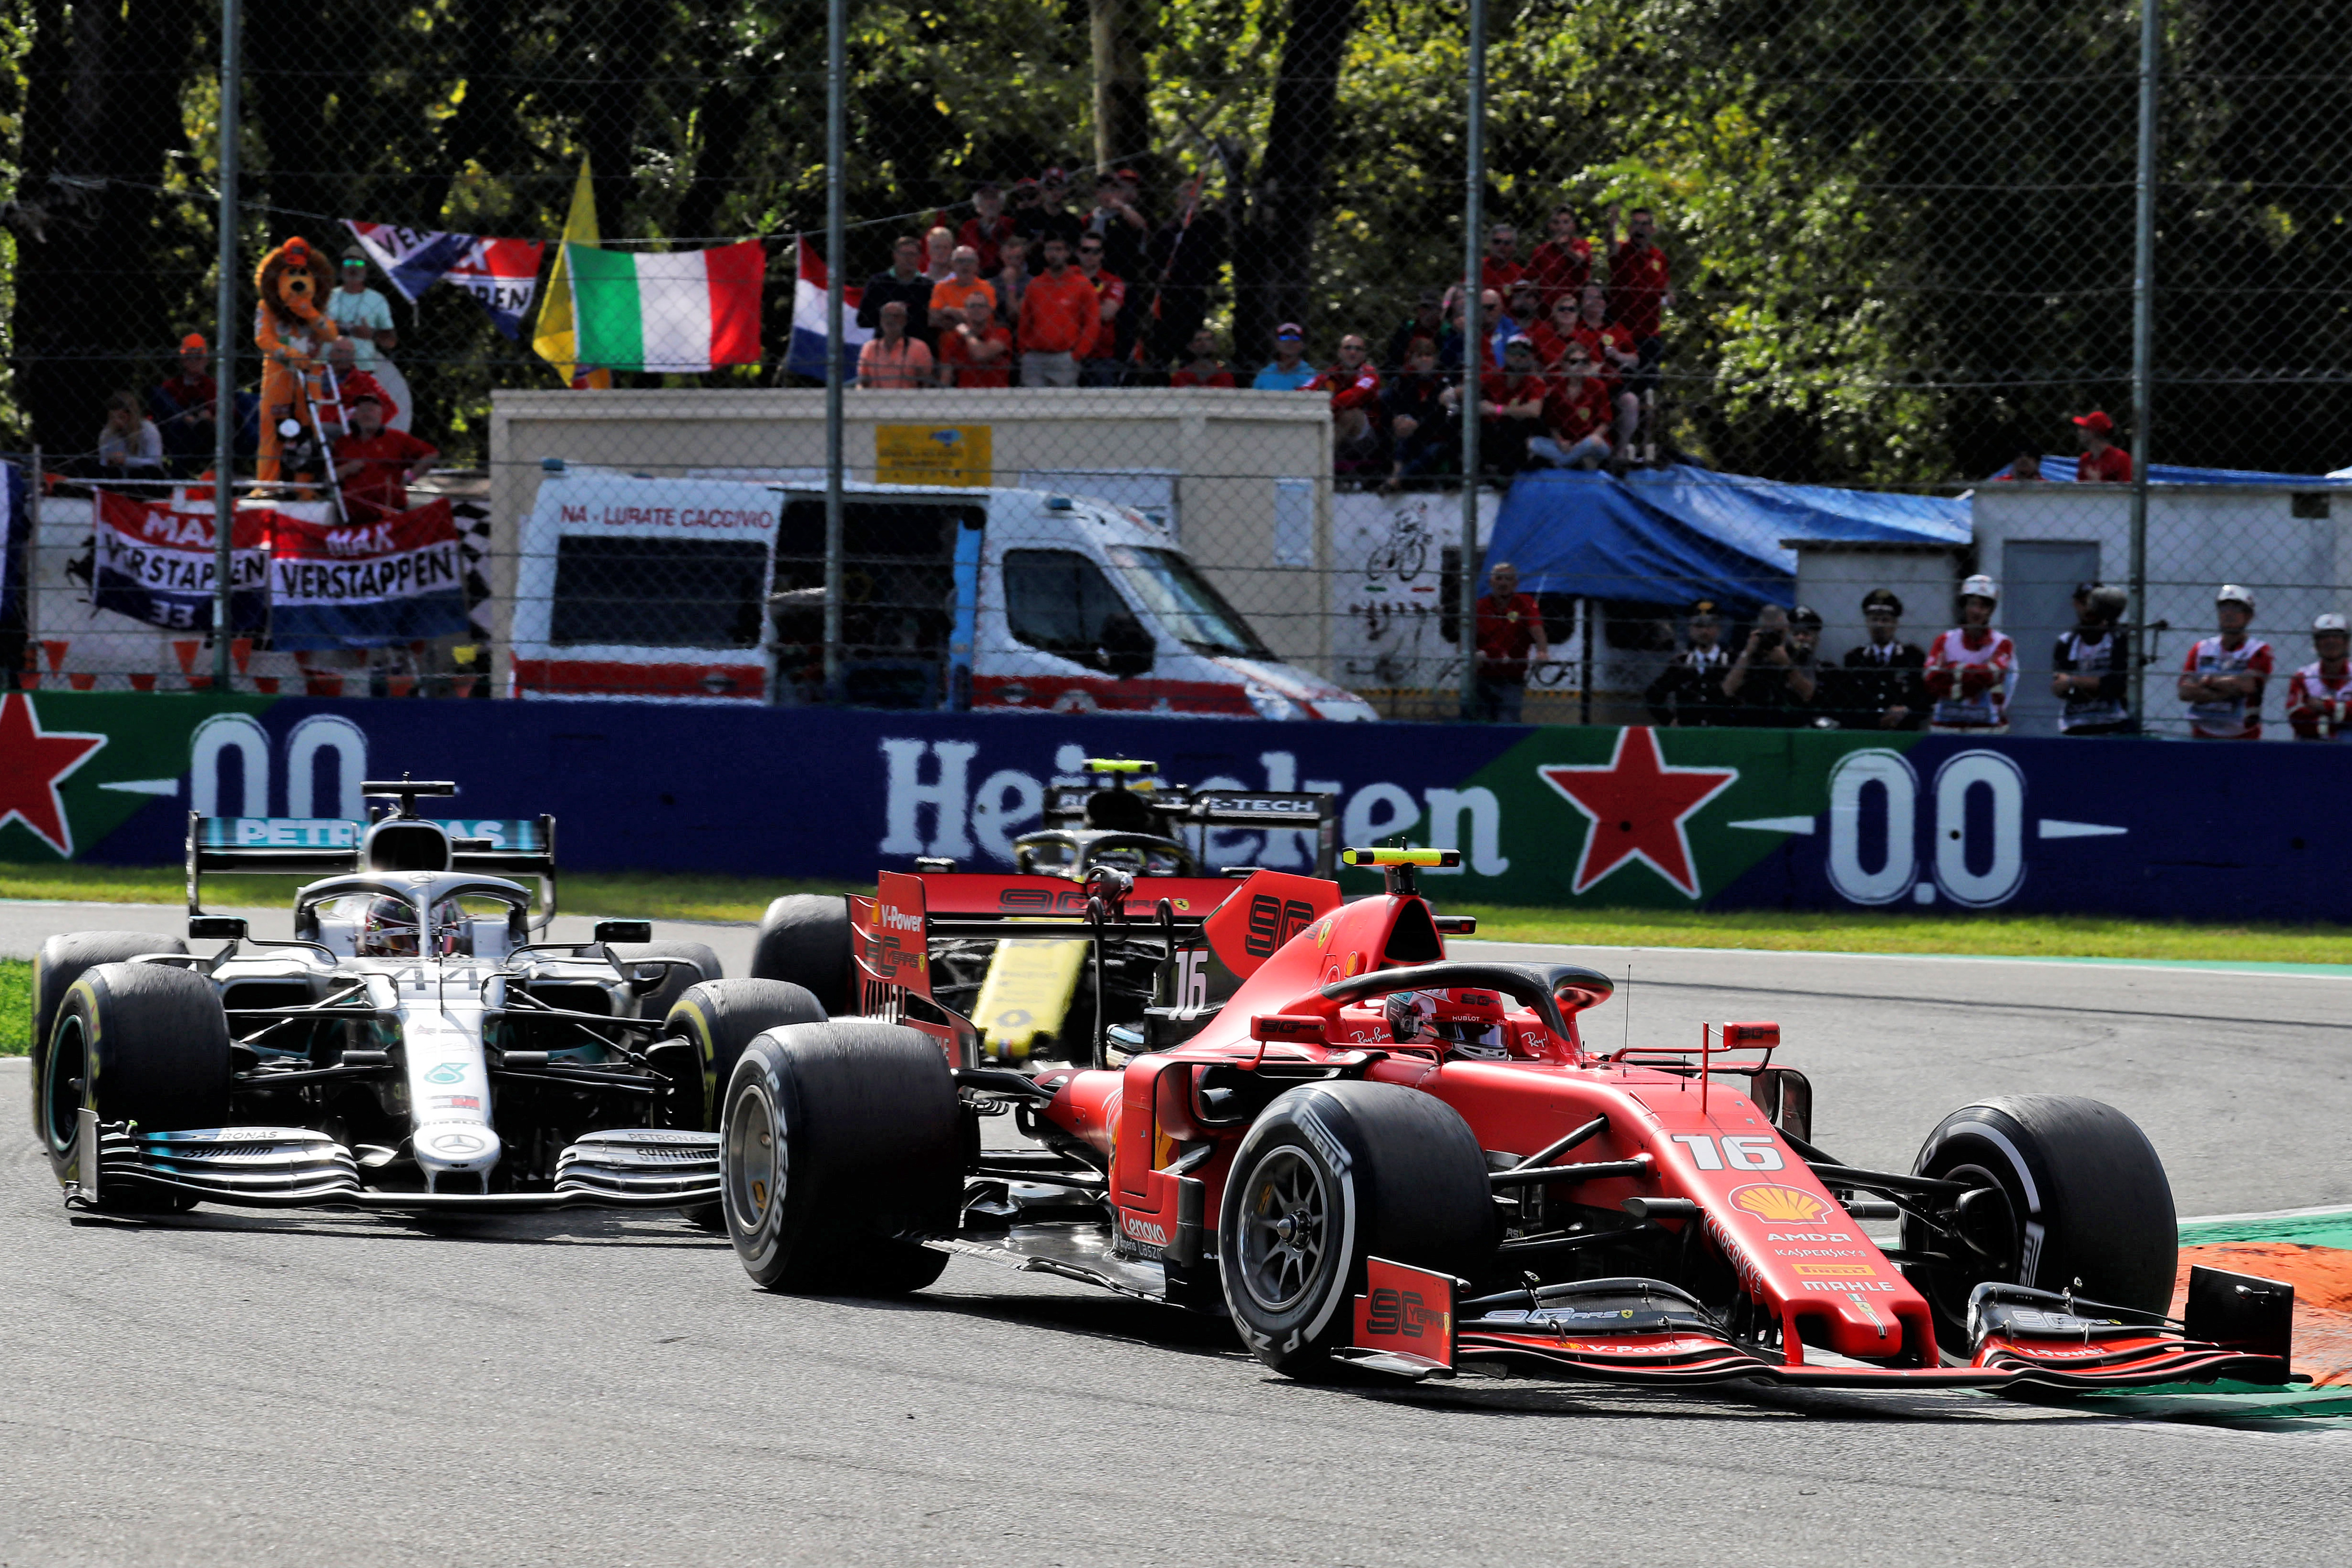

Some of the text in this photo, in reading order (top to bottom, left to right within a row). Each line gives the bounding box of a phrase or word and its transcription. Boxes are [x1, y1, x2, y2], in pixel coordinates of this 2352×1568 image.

[603, 507, 675, 527] LURATE
[280, 546, 453, 598] VERSTAPPEN
[150, 600, 196, 629] 33
[1828, 747, 2026, 907] 0.0
[881, 904, 922, 932] V-Power
[389, 967, 482, 990] 44
[1168, 948, 1209, 1021] 16
[628, 1133, 709, 1142] PETRONAS
[1670, 1133, 1785, 1171] 16
[1122, 1210, 1167, 1243] Lenovo
[1767, 1233, 1828, 1242] AMD
[1774, 1248, 1856, 1258] KASPERSKY
[1800, 1266, 1868, 1274] PIRELLI
[1801, 1281, 1896, 1291] MAHLE
[1366, 1288, 1445, 1338] 90 YEARS
[1480, 1307, 1575, 1323] 90
[2012, 1310, 2080, 1329] 90
[1586, 1339, 1703, 1353] V-Power
